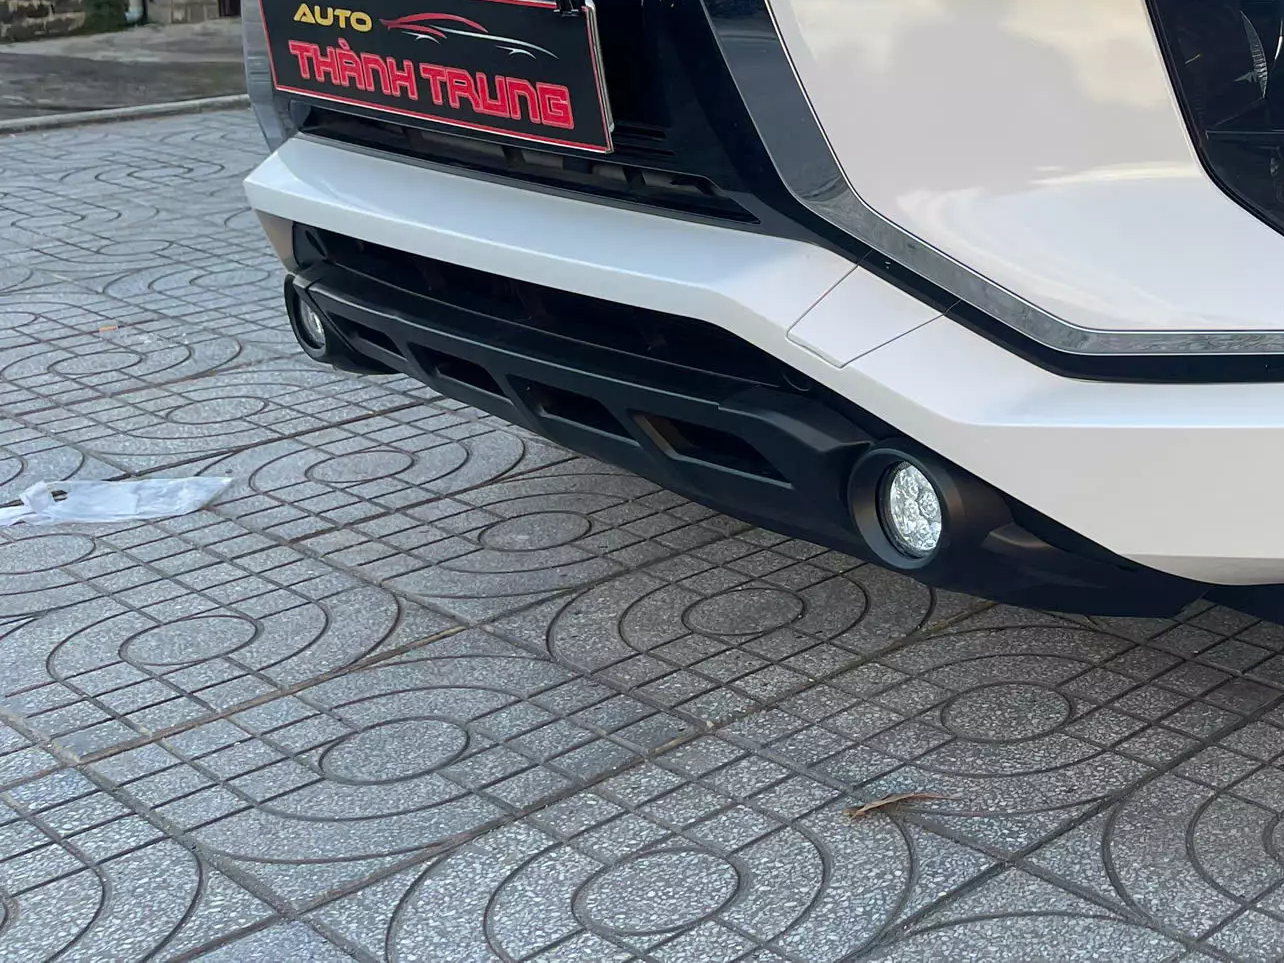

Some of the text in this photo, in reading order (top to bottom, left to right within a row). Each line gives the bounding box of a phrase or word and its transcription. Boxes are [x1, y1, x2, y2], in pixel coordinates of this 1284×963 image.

[293, 3, 373, 33] AUTO
[288, 38, 575, 131] THÀNH TRUNG
